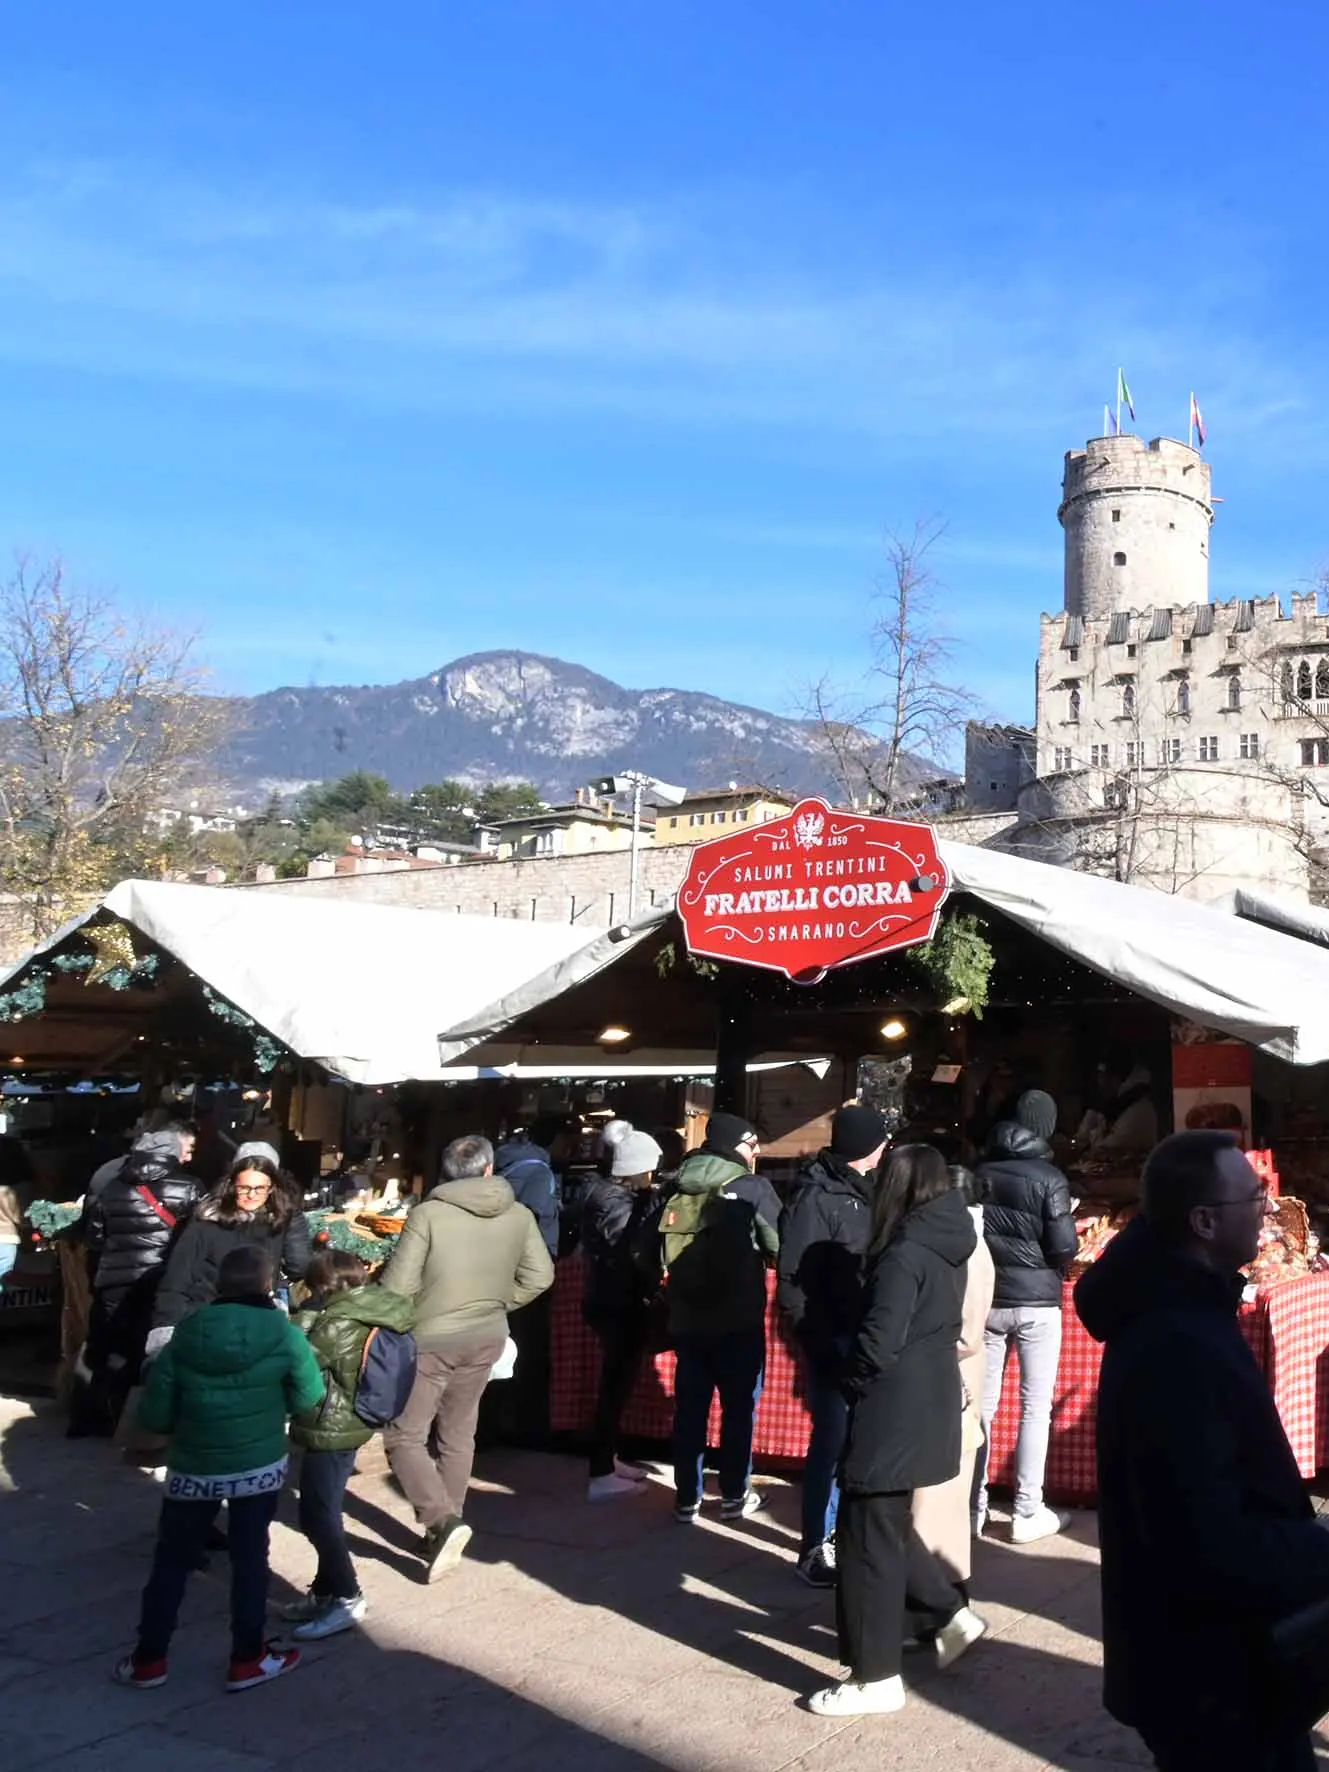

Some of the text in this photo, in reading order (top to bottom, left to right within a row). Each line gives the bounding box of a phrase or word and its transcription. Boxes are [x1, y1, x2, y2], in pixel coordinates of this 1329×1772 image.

[771, 835, 848, 851] DAL 1850
[734, 855, 886, 883] SALUMI TRENTINI
[703, 887, 818, 916] FRATELLI
[767, 921, 845, 941] SMARANO
